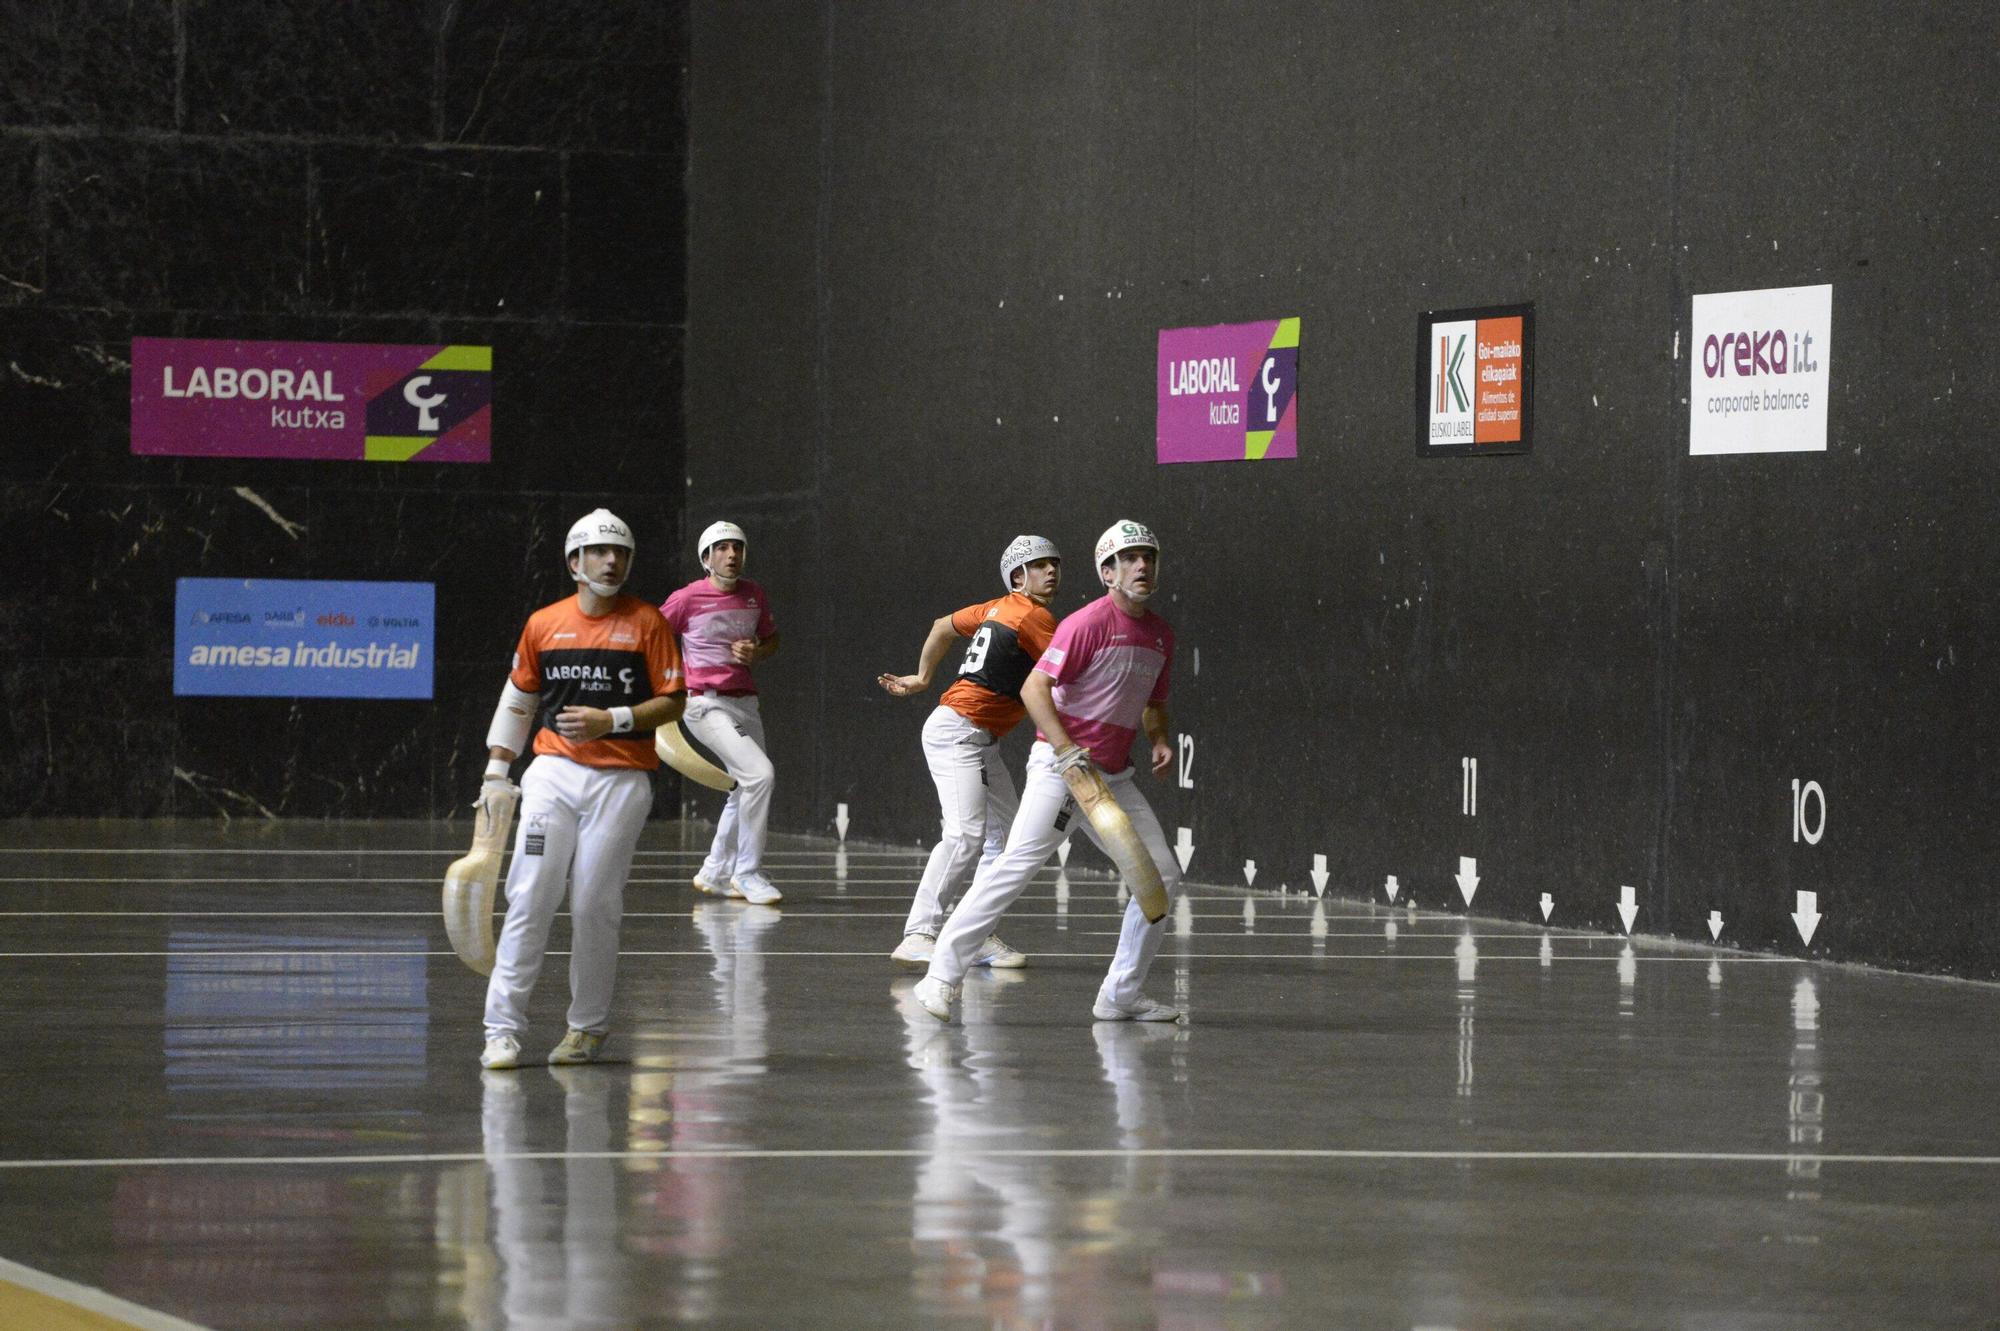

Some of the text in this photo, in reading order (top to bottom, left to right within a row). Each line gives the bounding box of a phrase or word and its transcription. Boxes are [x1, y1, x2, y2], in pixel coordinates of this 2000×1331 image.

[1703, 329, 1788, 379] oreka
[163, 366, 345, 402] LABORAL
[1169, 356, 1240, 396] LABORAL
[270, 406, 345, 430] kutxa
[1209, 400, 1240, 426] kutxa
[1707, 388, 1810, 418] corporate balance
[1431, 420, 1473, 438] EUSKO LABEL
[189, 639, 420, 670] amesa industrial
[545, 665, 612, 681] LABORAL
[1177, 733, 1195, 789] 12
[1461, 756, 1478, 817] 11
[1791, 777, 1827, 846] 10
